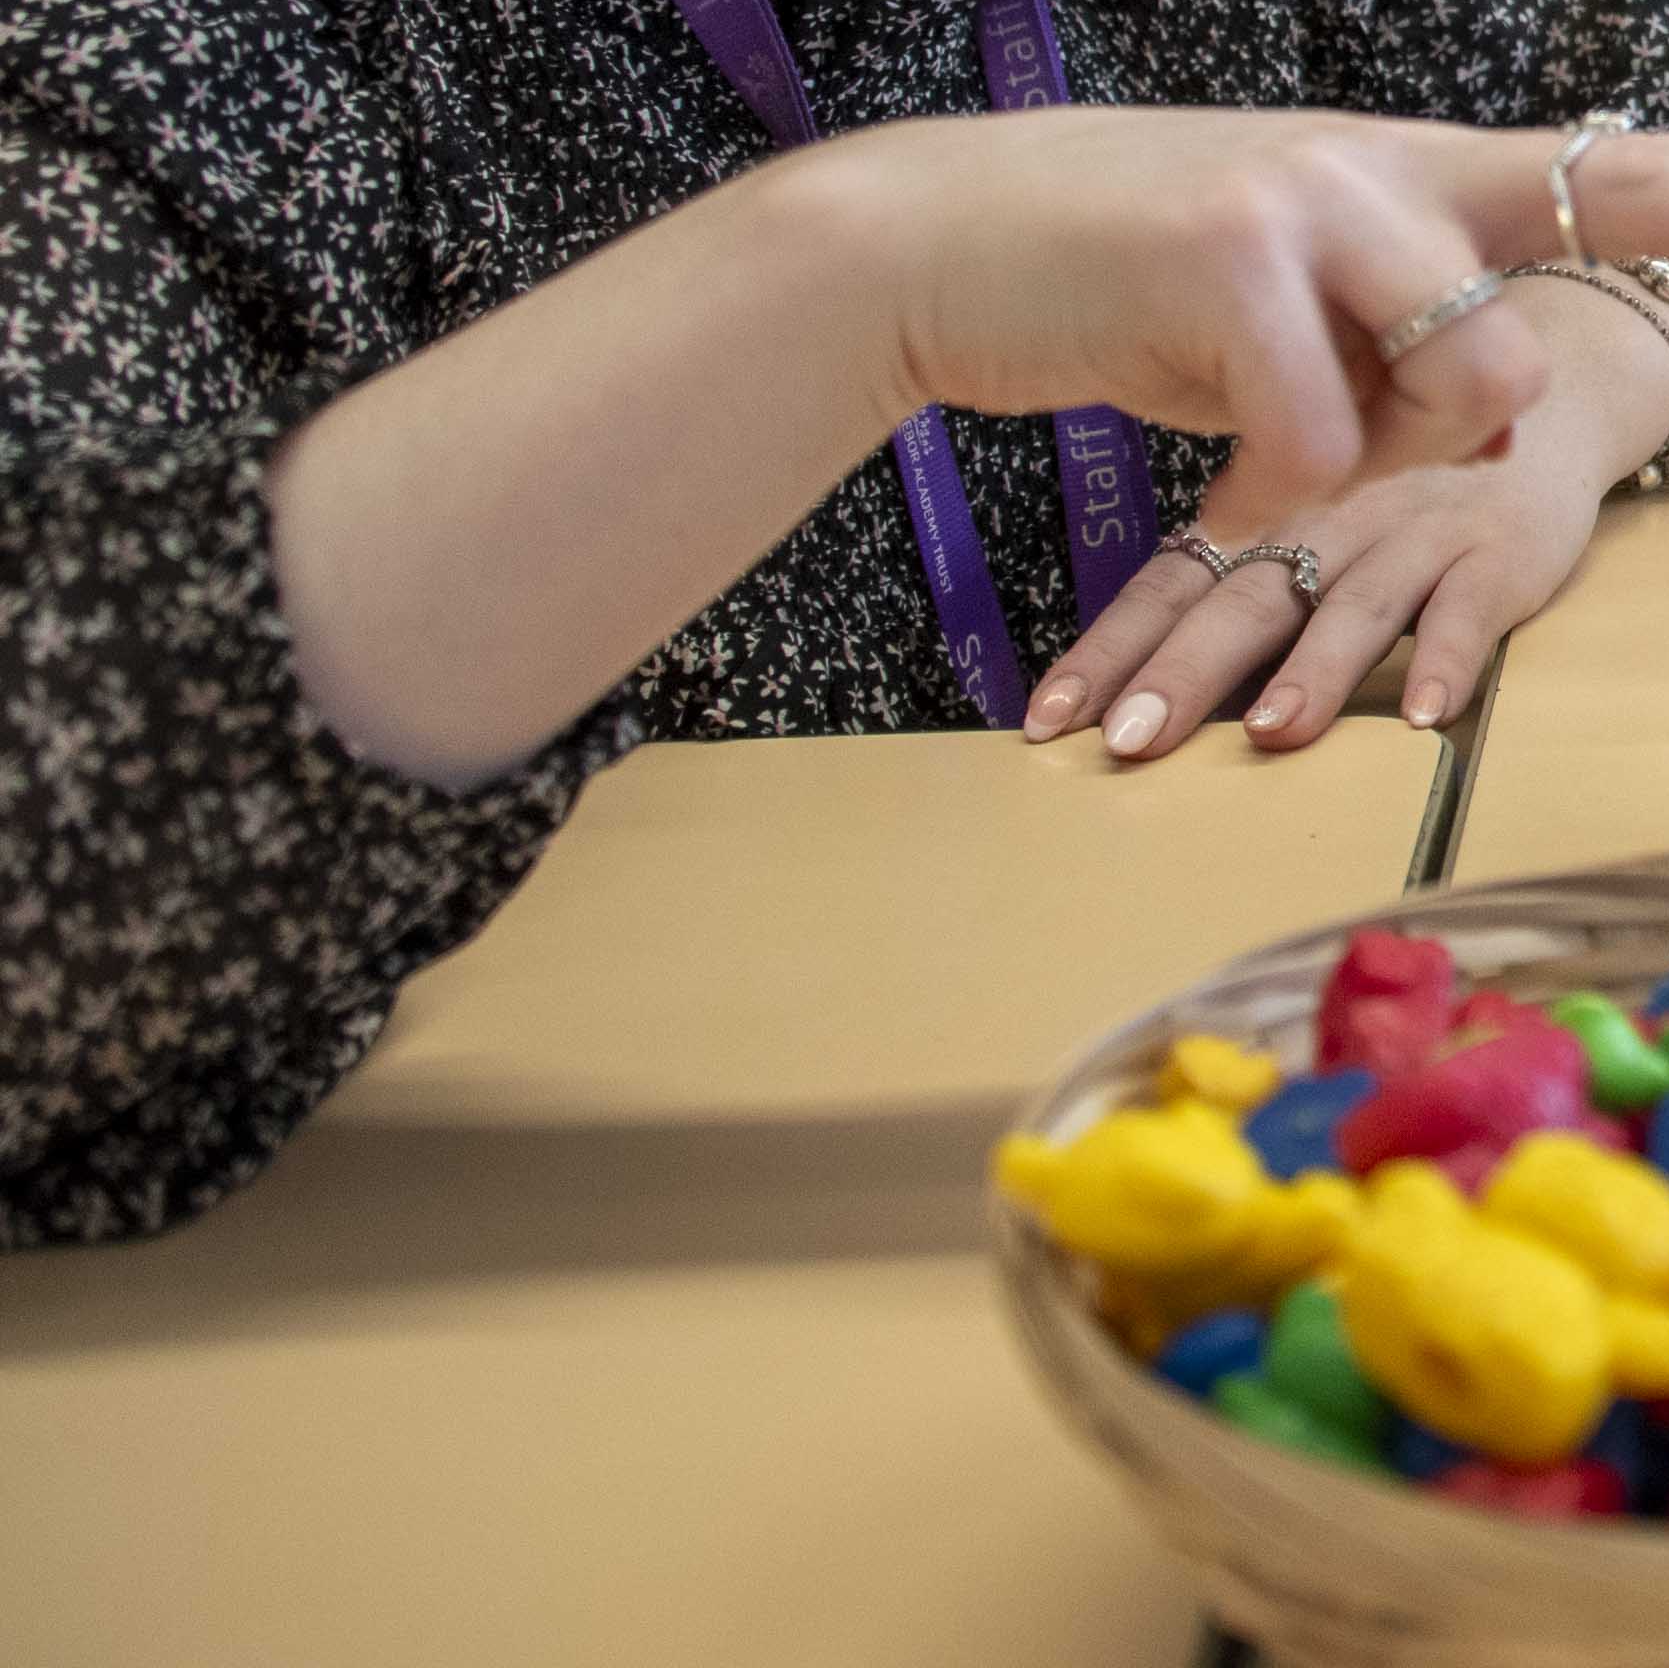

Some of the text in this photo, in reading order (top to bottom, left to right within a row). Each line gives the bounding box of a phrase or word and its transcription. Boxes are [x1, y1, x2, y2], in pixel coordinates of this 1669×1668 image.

[902, 419, 953, 595] EBOR ACADEMY TRUST
[1067, 424, 1125, 549] Staff
